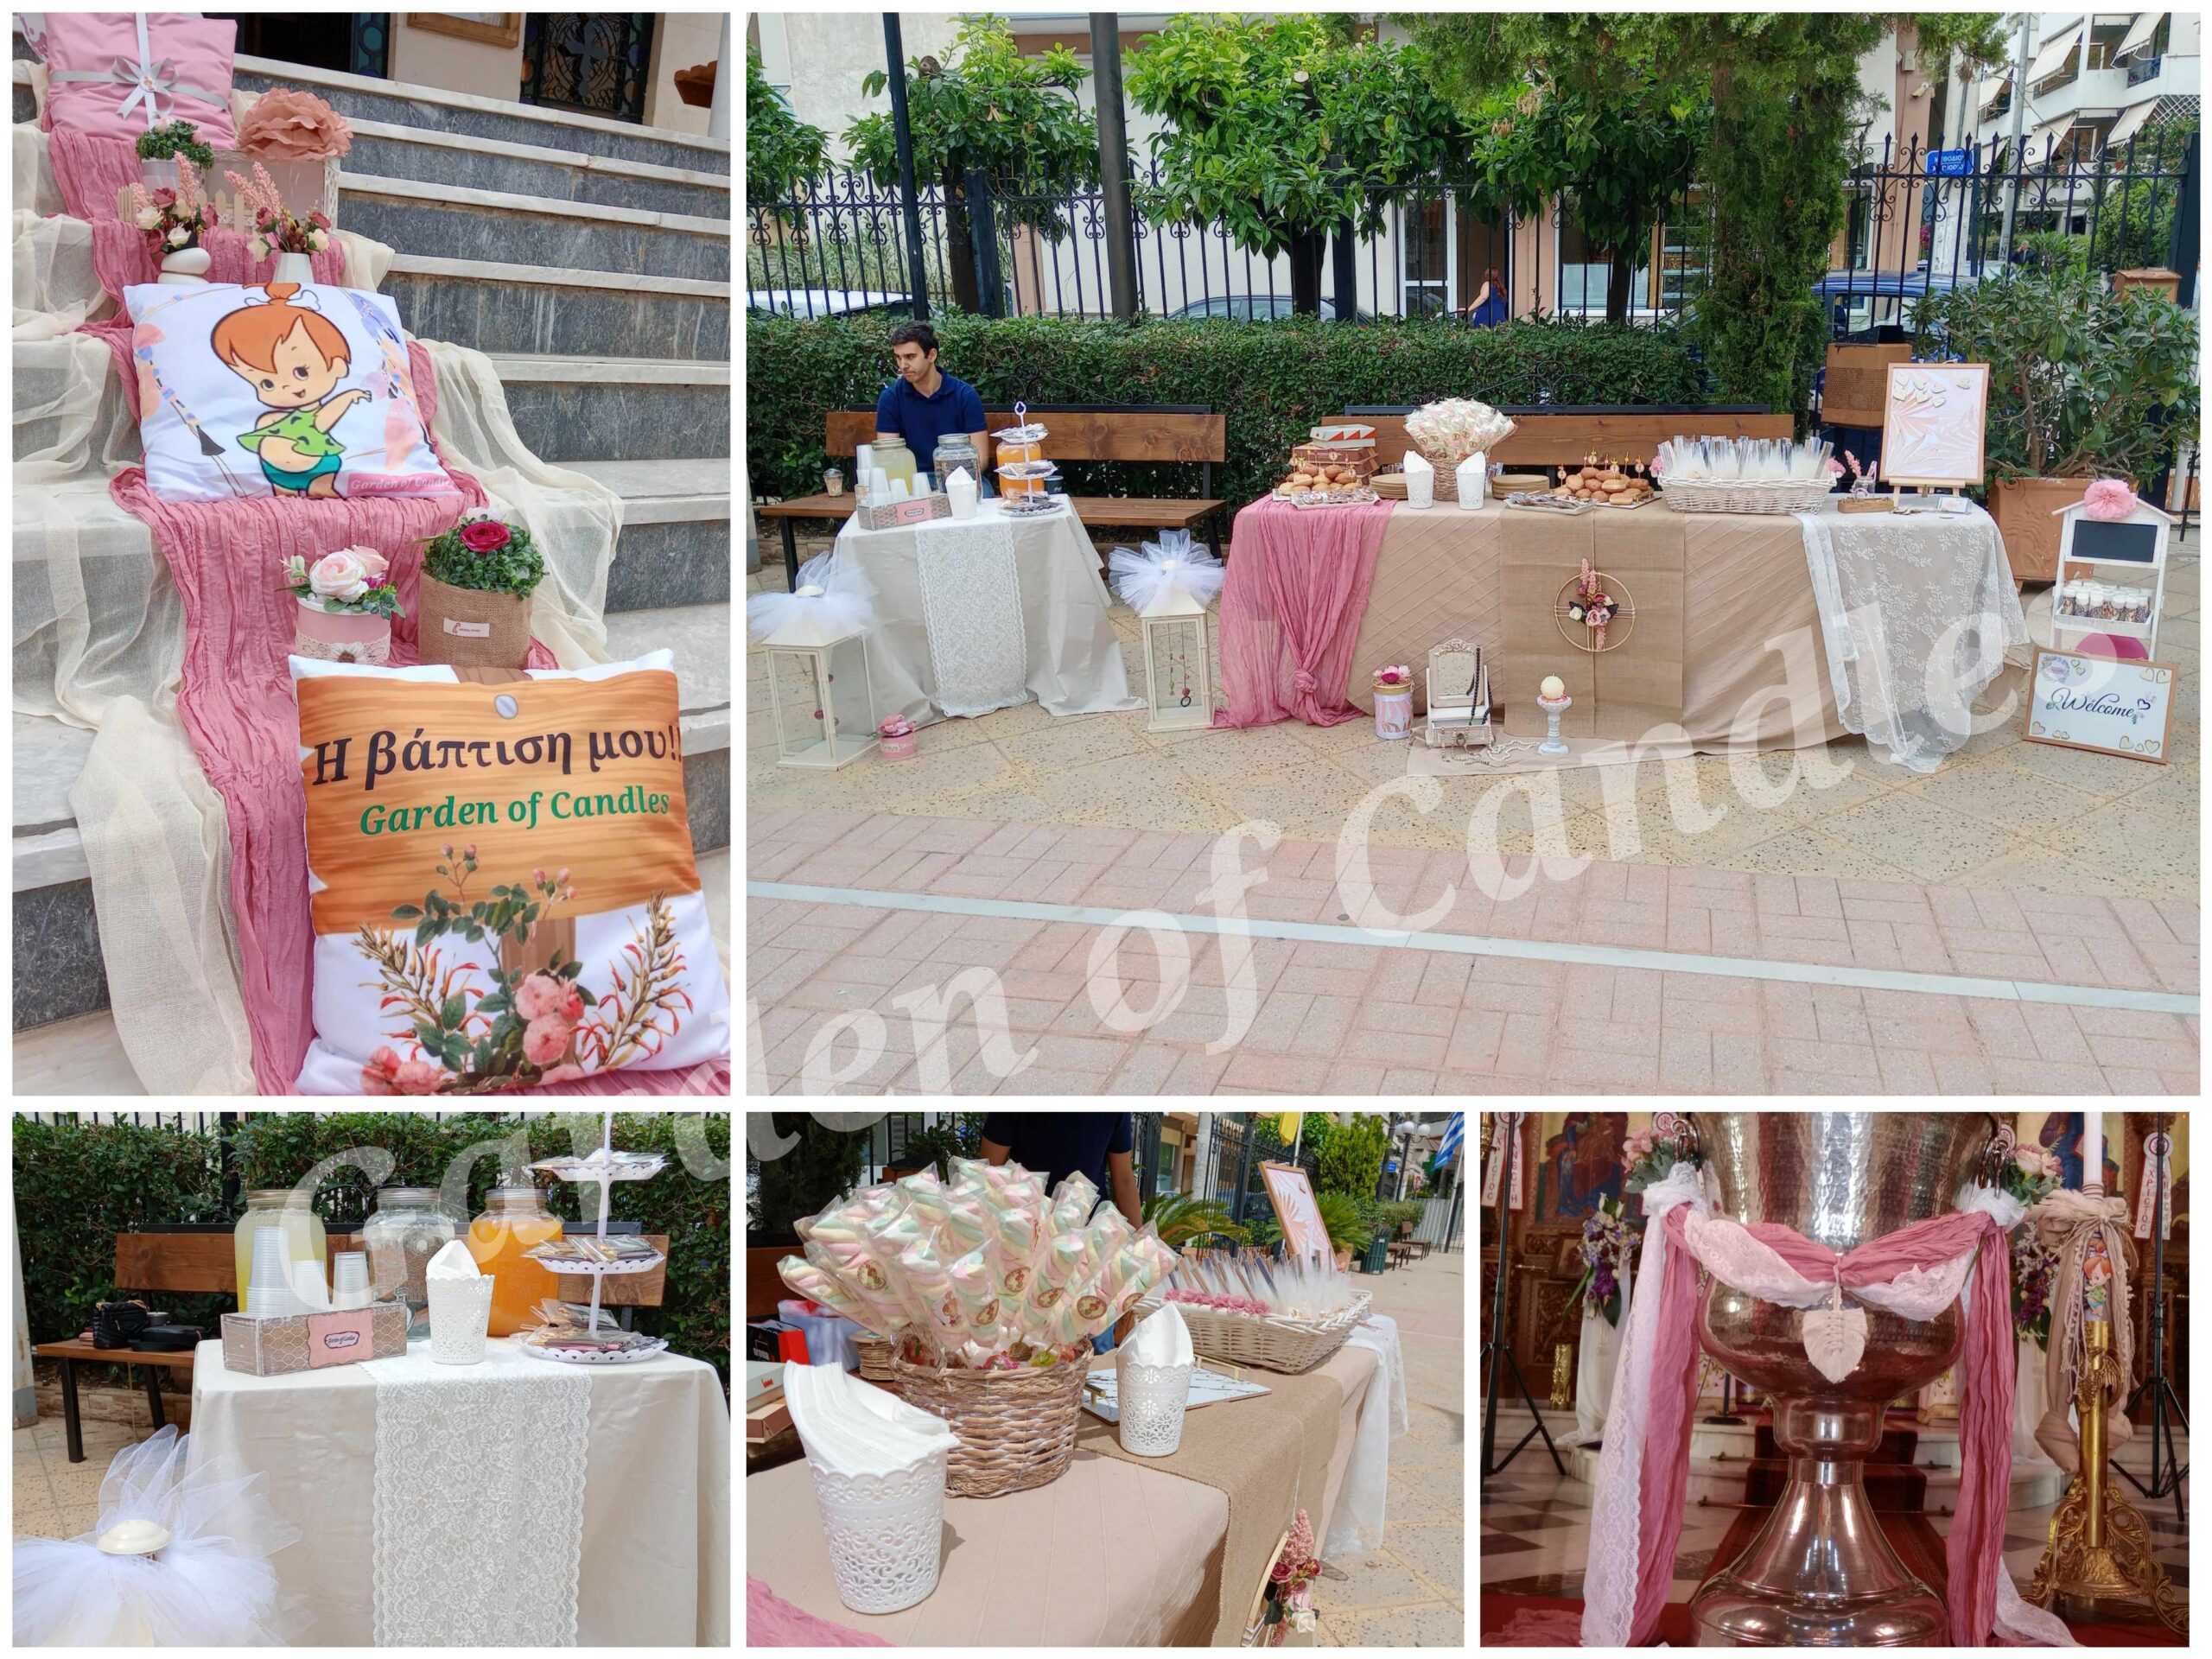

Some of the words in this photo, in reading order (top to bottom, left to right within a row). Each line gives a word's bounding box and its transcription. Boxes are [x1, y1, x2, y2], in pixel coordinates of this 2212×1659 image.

[351, 479, 397, 490] Garden
[400, 477, 413, 489] of
[2051, 687, 2135, 718] Welcome
[312, 738, 353, 785] Η
[365, 728, 572, 790] βάπτιση
[359, 795, 499, 836] Garden
[508, 791, 543, 830] of
[550, 785, 670, 819] Candles
